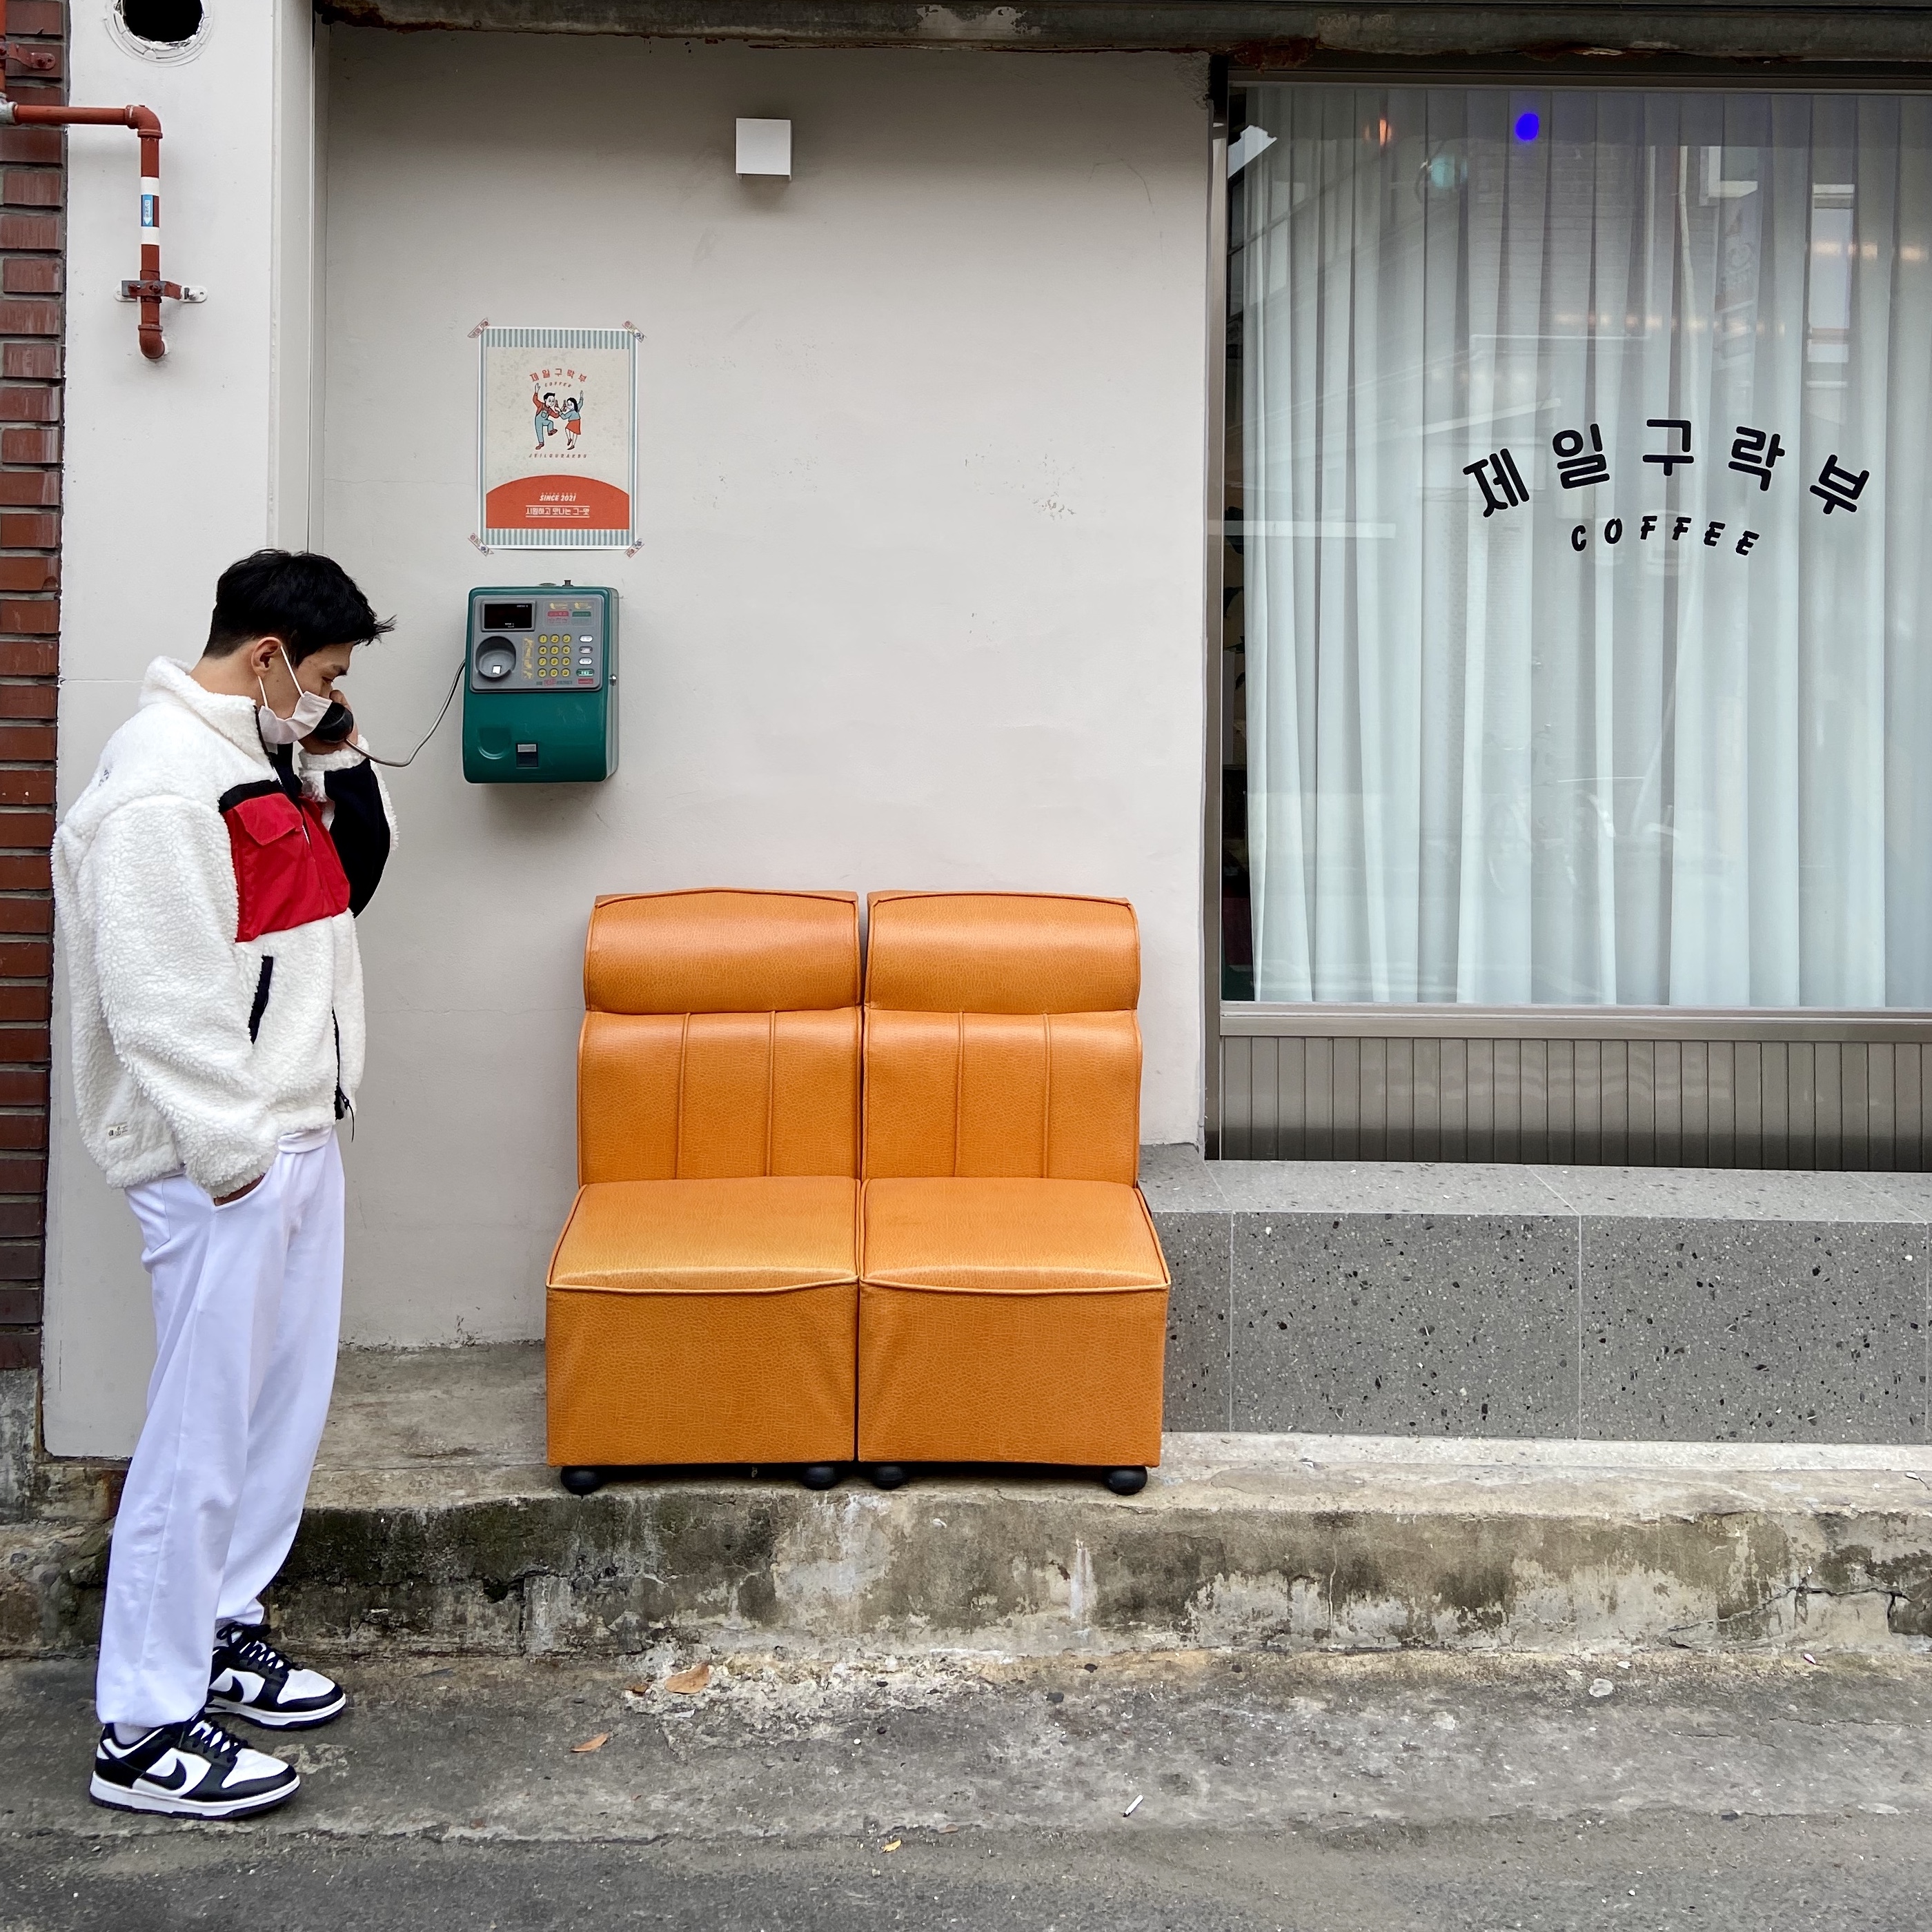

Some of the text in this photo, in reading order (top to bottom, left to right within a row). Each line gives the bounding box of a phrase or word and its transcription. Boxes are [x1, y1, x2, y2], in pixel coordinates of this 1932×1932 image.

[529, 368, 587, 382] 제일구락부
[1461, 418, 1871, 519] 제일구락부
[525, 507, 551, 515] 시원하고
[1570, 515, 1761, 557] COFFEE
